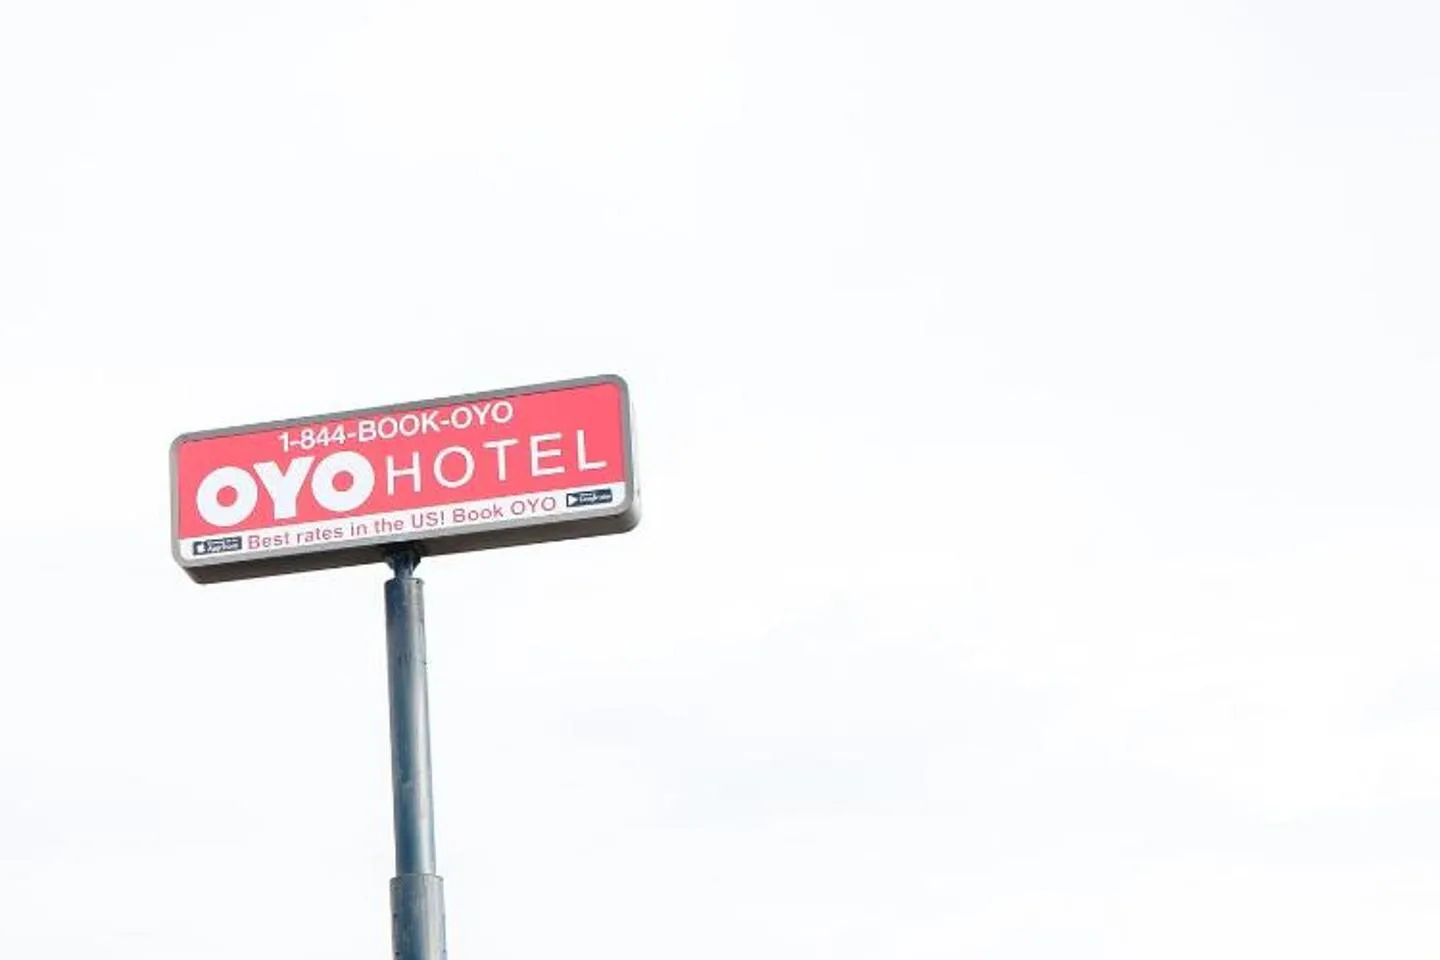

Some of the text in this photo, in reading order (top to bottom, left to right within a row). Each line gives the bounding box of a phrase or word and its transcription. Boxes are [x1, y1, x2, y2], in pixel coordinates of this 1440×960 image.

[279, 400, 513, 453] 1-844-BOOK-OYO
[196, 428, 608, 527] OYO HOTEL
[247, 531, 290, 550] Best
[296, 526, 344, 544] rates
[350, 521, 368, 537] in
[374, 517, 405, 534] the
[411, 511, 446, 530] US!
[452, 504, 505, 524] Book
[511, 496, 556, 517] OYO
